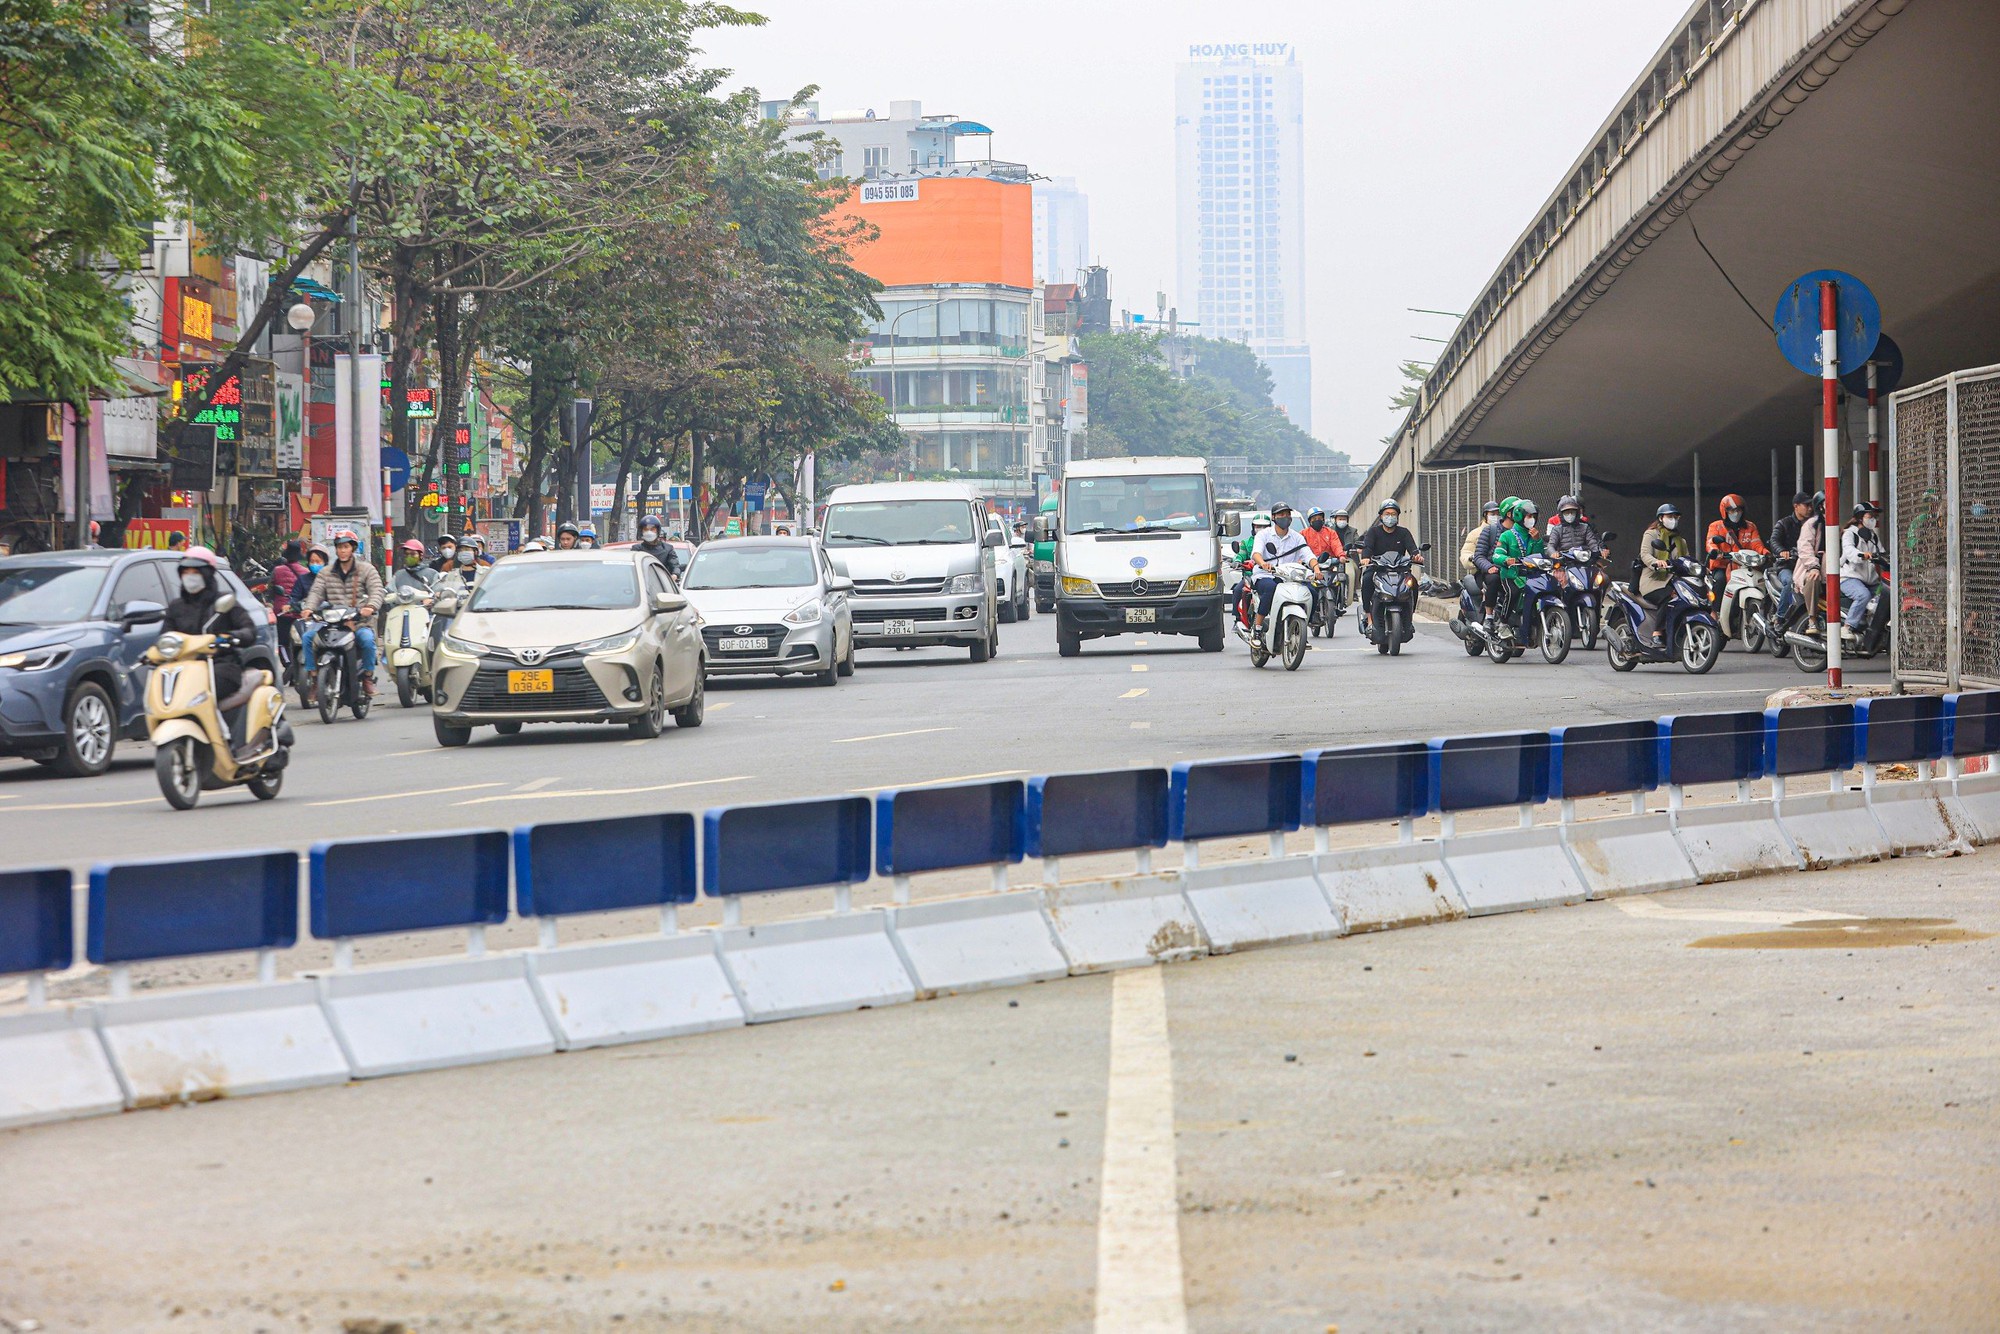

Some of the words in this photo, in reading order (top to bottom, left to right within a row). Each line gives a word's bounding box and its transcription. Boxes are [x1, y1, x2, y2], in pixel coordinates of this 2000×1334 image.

[1189, 43, 1248, 56] HOANG
[1253, 43, 1287, 55] HUY
[865, 187, 883, 200] 0945
[885, 186, 898, 199] 551
[900, 185, 914, 198] 085
[521, 671, 540, 681] 29E
